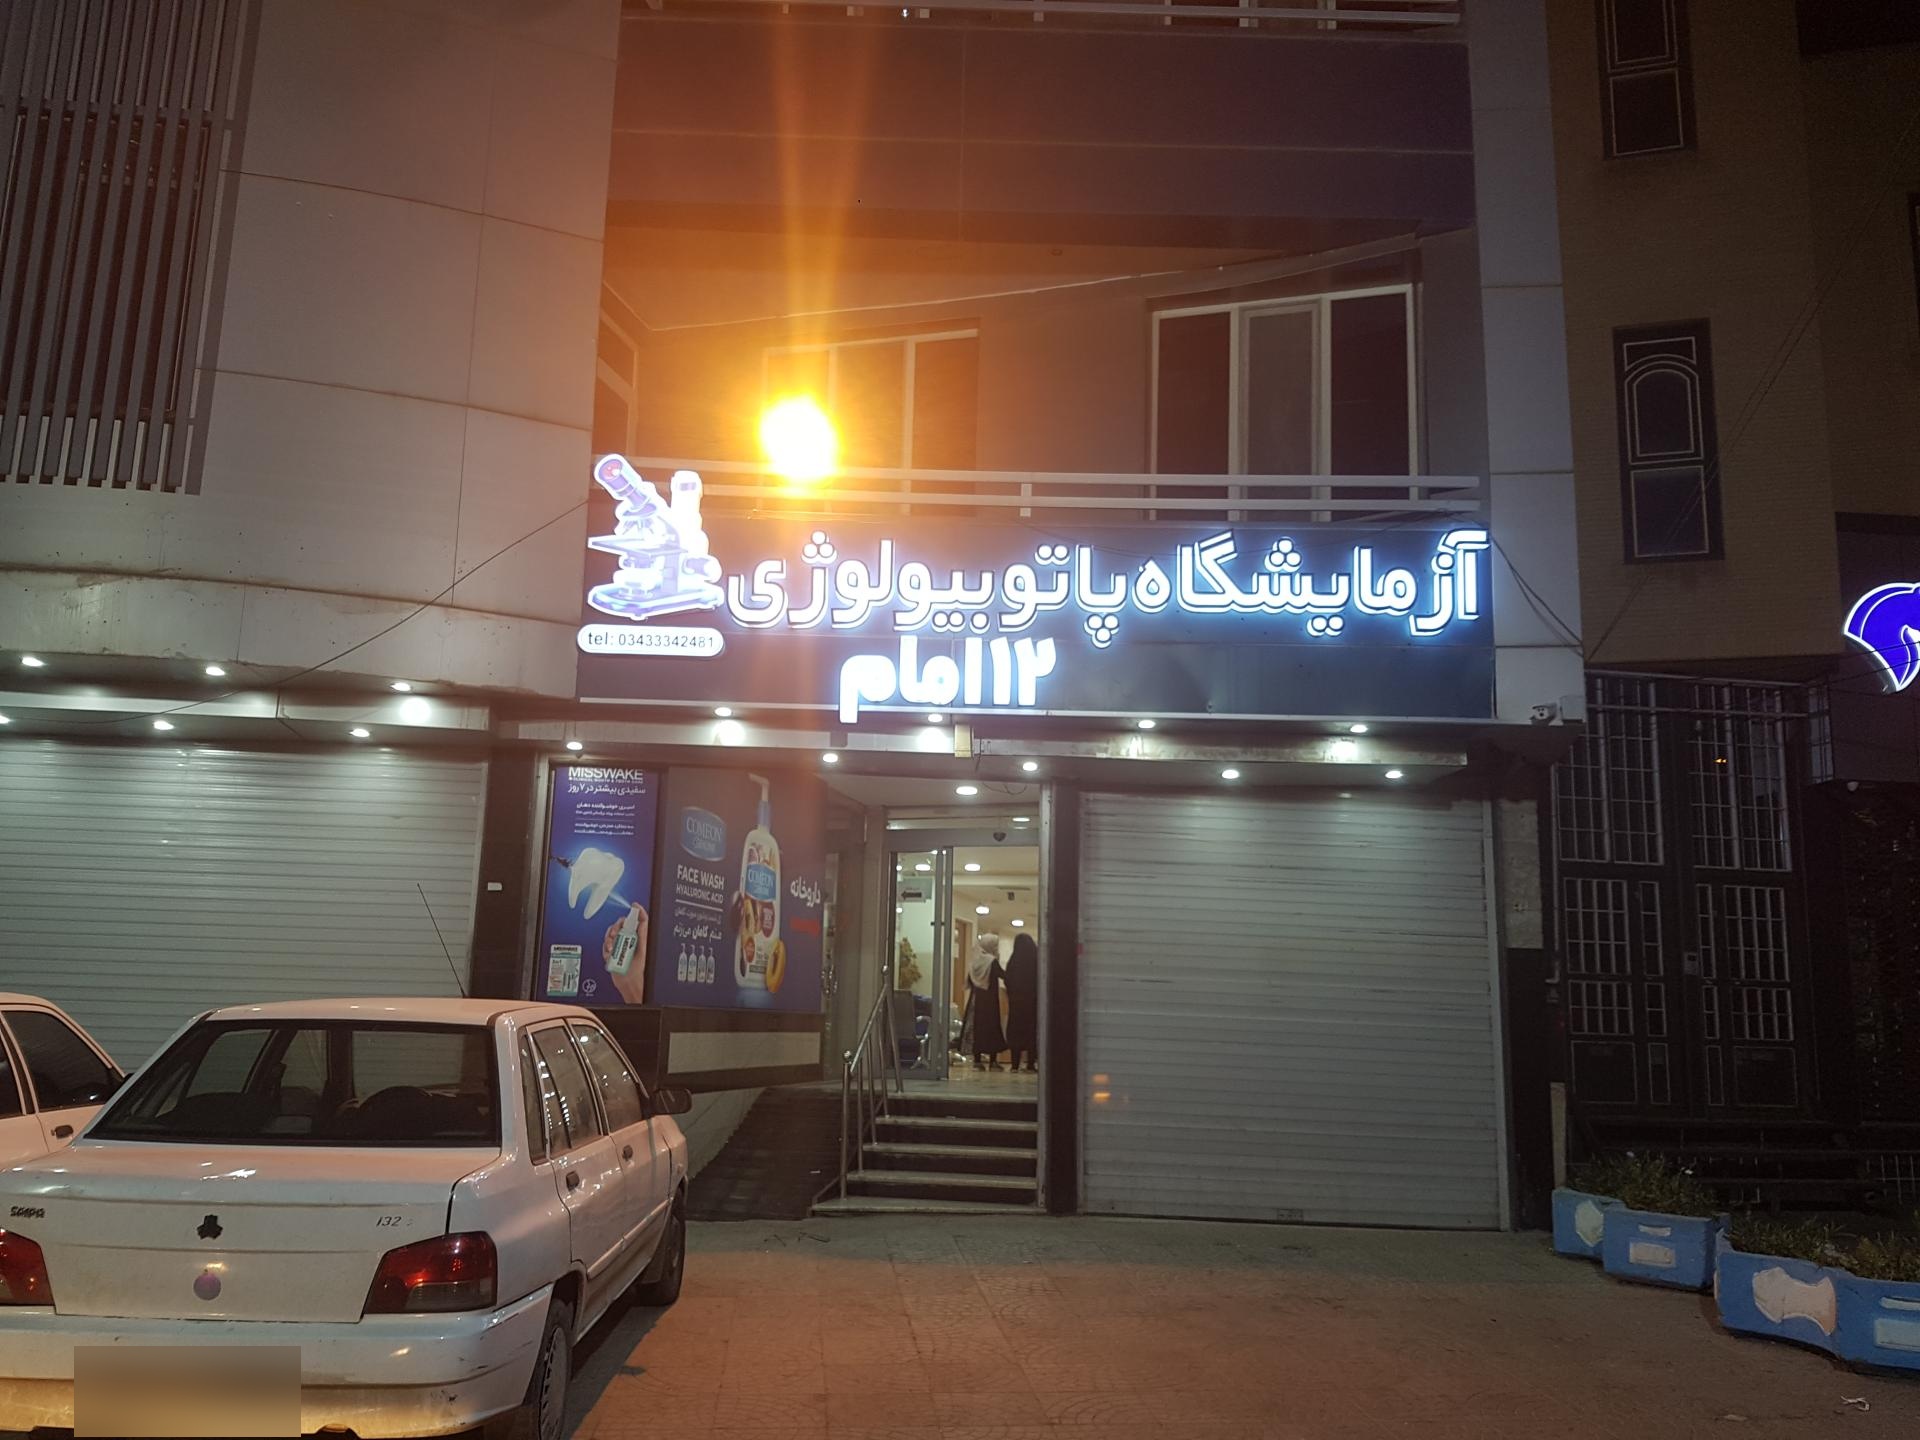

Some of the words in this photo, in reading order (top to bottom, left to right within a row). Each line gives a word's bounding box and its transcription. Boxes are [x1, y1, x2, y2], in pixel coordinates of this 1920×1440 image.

[726, 530, 1128, 648] پاتوبیولوژی
[1131, 528, 1490, 637] آزمایشگاه
[588, 632, 614, 645] tel:
[618, 633, 714, 648] 03433342481
[838, 635, 984, 724] امام
[568, 766, 643, 781] MISSWAKE
[568, 783, 580, 793] روز
[579, 782, 586, 791] ۷
[585, 784, 594, 794] در
[593, 784, 617, 795] بیشتر
[617, 785, 646, 796] سفیدی
[677, 864, 699, 884] FACE
[700, 870, 725, 891] WASH
[676, 883, 711, 902] HYALURONIC
[711, 892, 724, 905] ACID
[790, 875, 821, 908] داروخانه
[375, 1215, 402, 1228] 132
